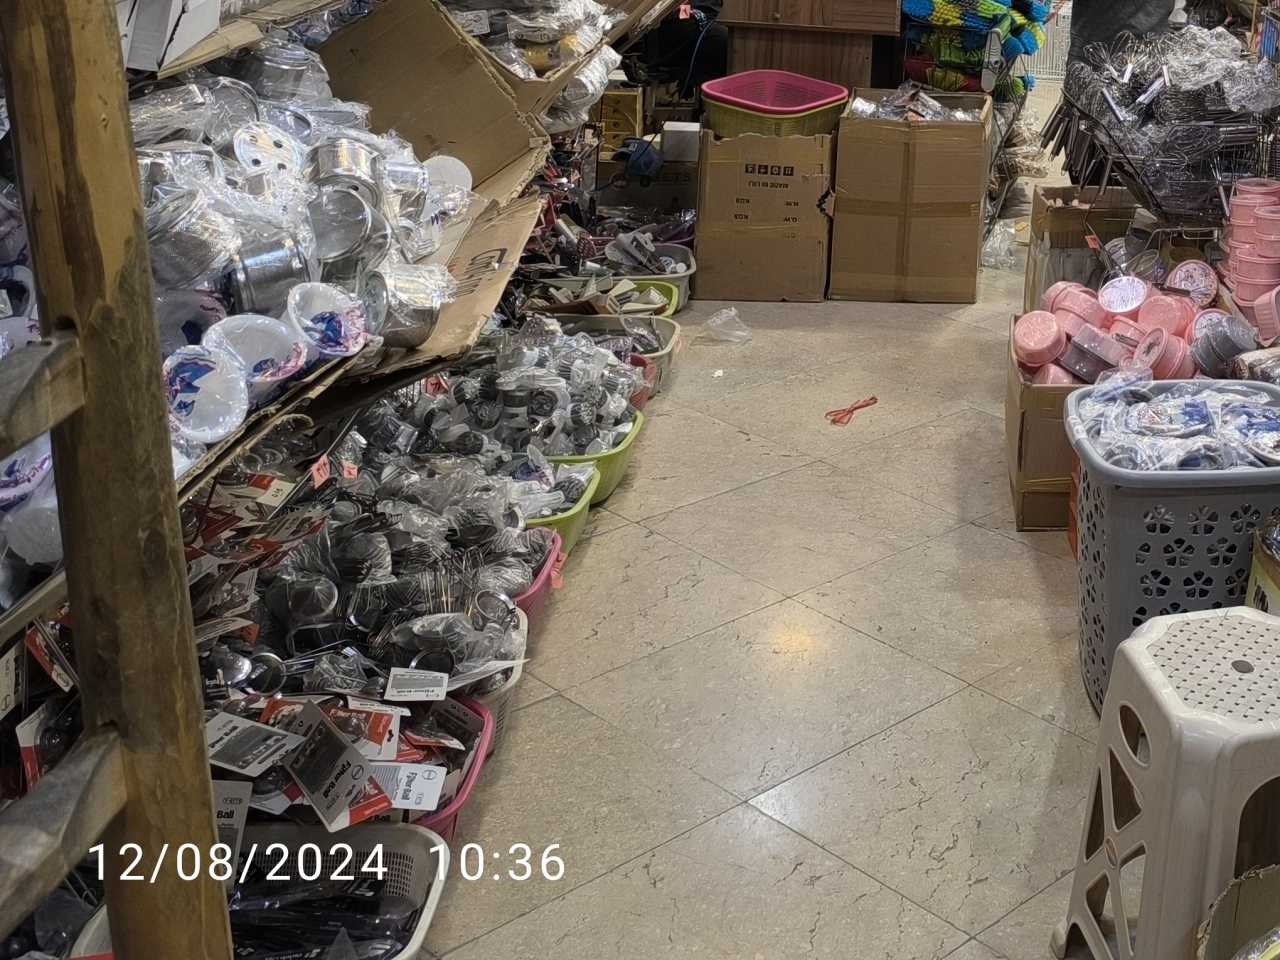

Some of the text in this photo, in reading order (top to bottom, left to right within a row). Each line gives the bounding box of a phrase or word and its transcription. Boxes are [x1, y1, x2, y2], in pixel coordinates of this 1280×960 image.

[322, 781, 336, 799] Ball
[400, 772, 417, 801] Filter Ball
[217, 810, 234, 819] Ball
